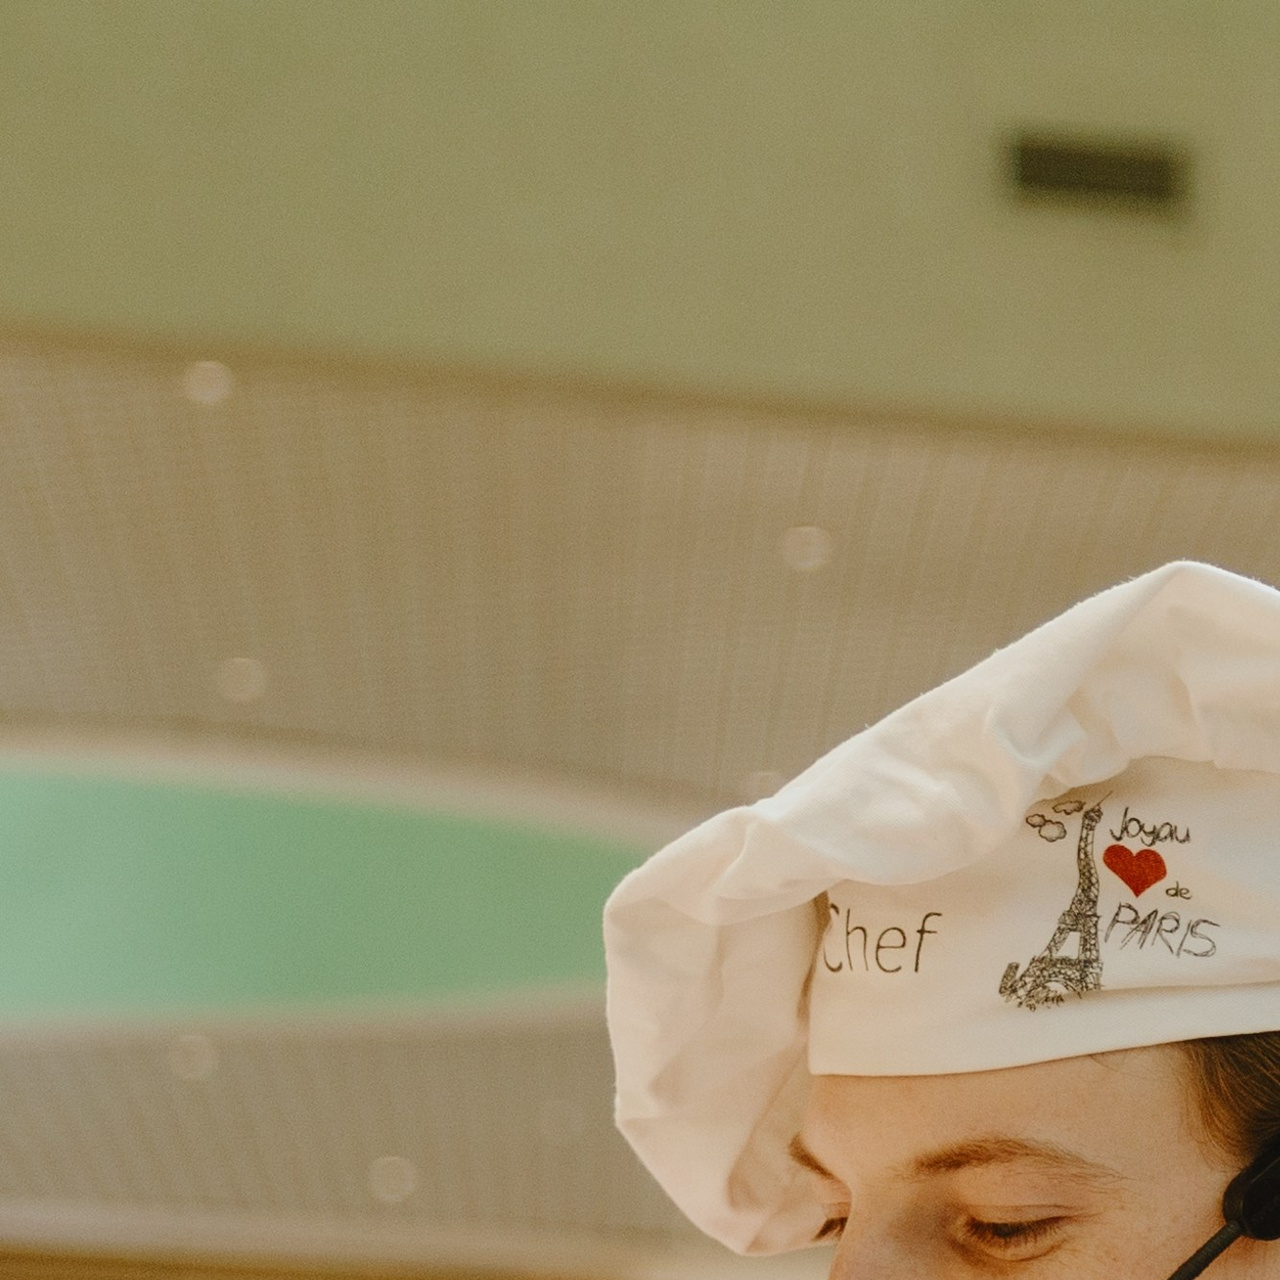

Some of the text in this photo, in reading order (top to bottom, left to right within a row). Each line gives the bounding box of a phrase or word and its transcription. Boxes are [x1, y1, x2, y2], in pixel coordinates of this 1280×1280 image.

[1109, 806, 1191, 847] Joyau
[1165, 880, 1192, 900] de
[822, 902, 943, 974] Chef
[1104, 901, 1221, 959] PARIS
